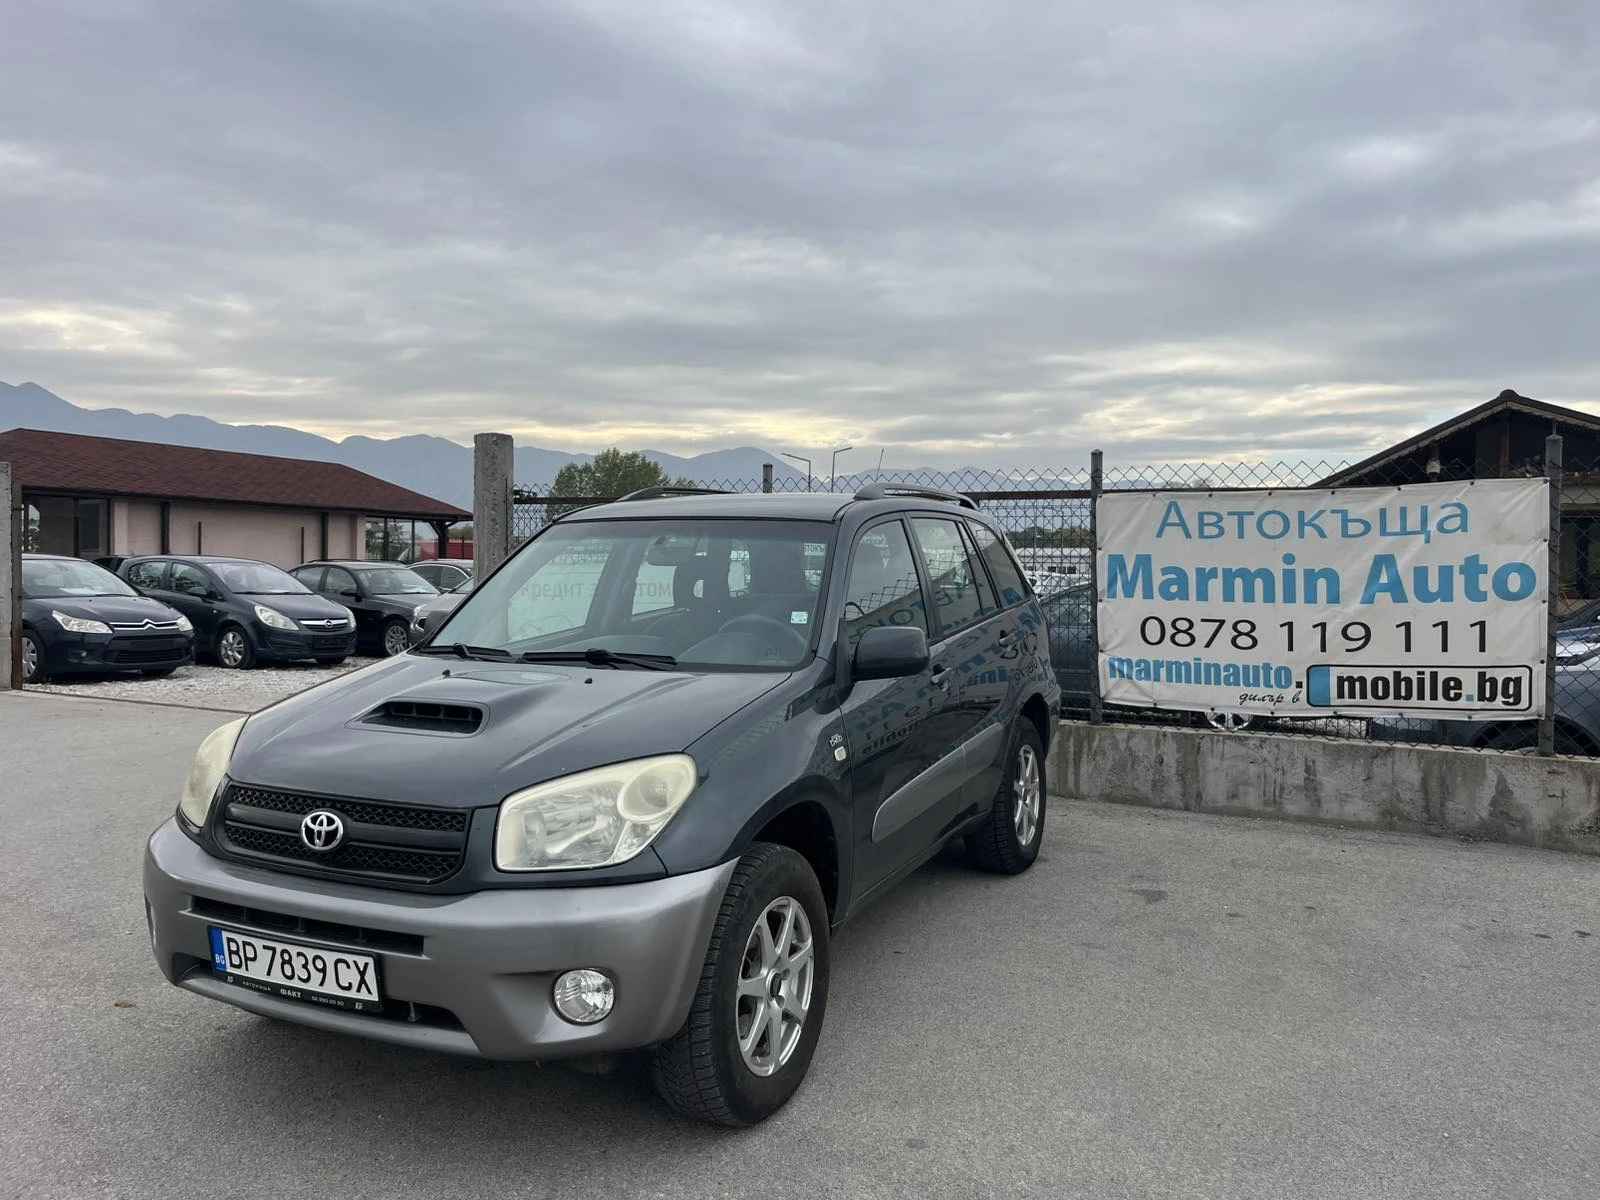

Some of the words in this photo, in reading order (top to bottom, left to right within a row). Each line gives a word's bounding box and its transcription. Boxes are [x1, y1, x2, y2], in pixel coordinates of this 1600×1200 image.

[1155, 500, 1469, 545] Автокъща
[1106, 552, 1341, 605] Marmin
[1359, 553, 1537, 605] Auto
[1139, 615, 1258, 651] 0878
[1279, 620, 1372, 653] 119
[1395, 620, 1487, 653] 111
[1336, 670, 1522, 707] mobile.bg
[215, 953, 226, 965] BG
